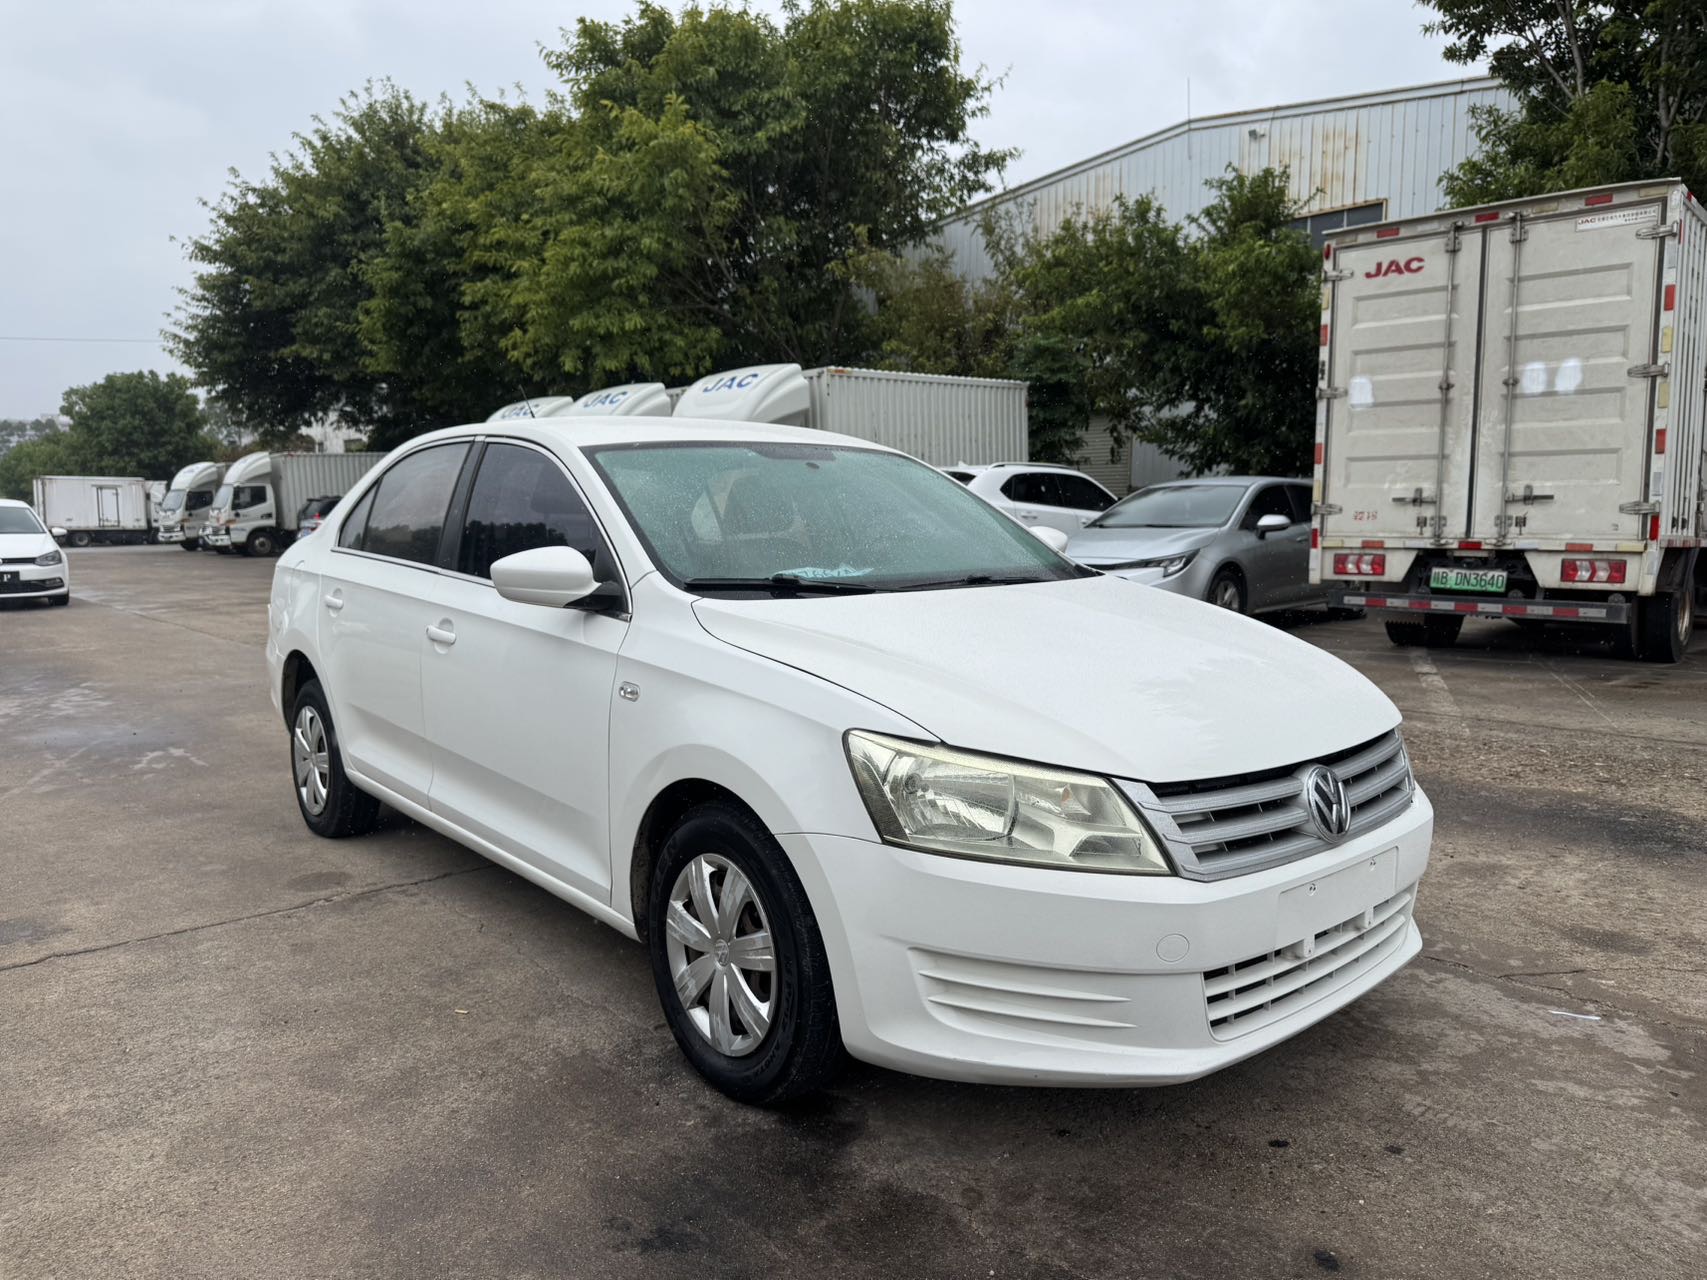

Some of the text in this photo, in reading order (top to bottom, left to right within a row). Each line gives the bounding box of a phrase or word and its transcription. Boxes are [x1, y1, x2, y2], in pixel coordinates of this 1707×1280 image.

[1577, 217, 1597, 225] JAC
[1364, 257, 1425, 279] JAC
[702, 373, 759, 393] JAC
[583, 391, 628, 408] JAC
